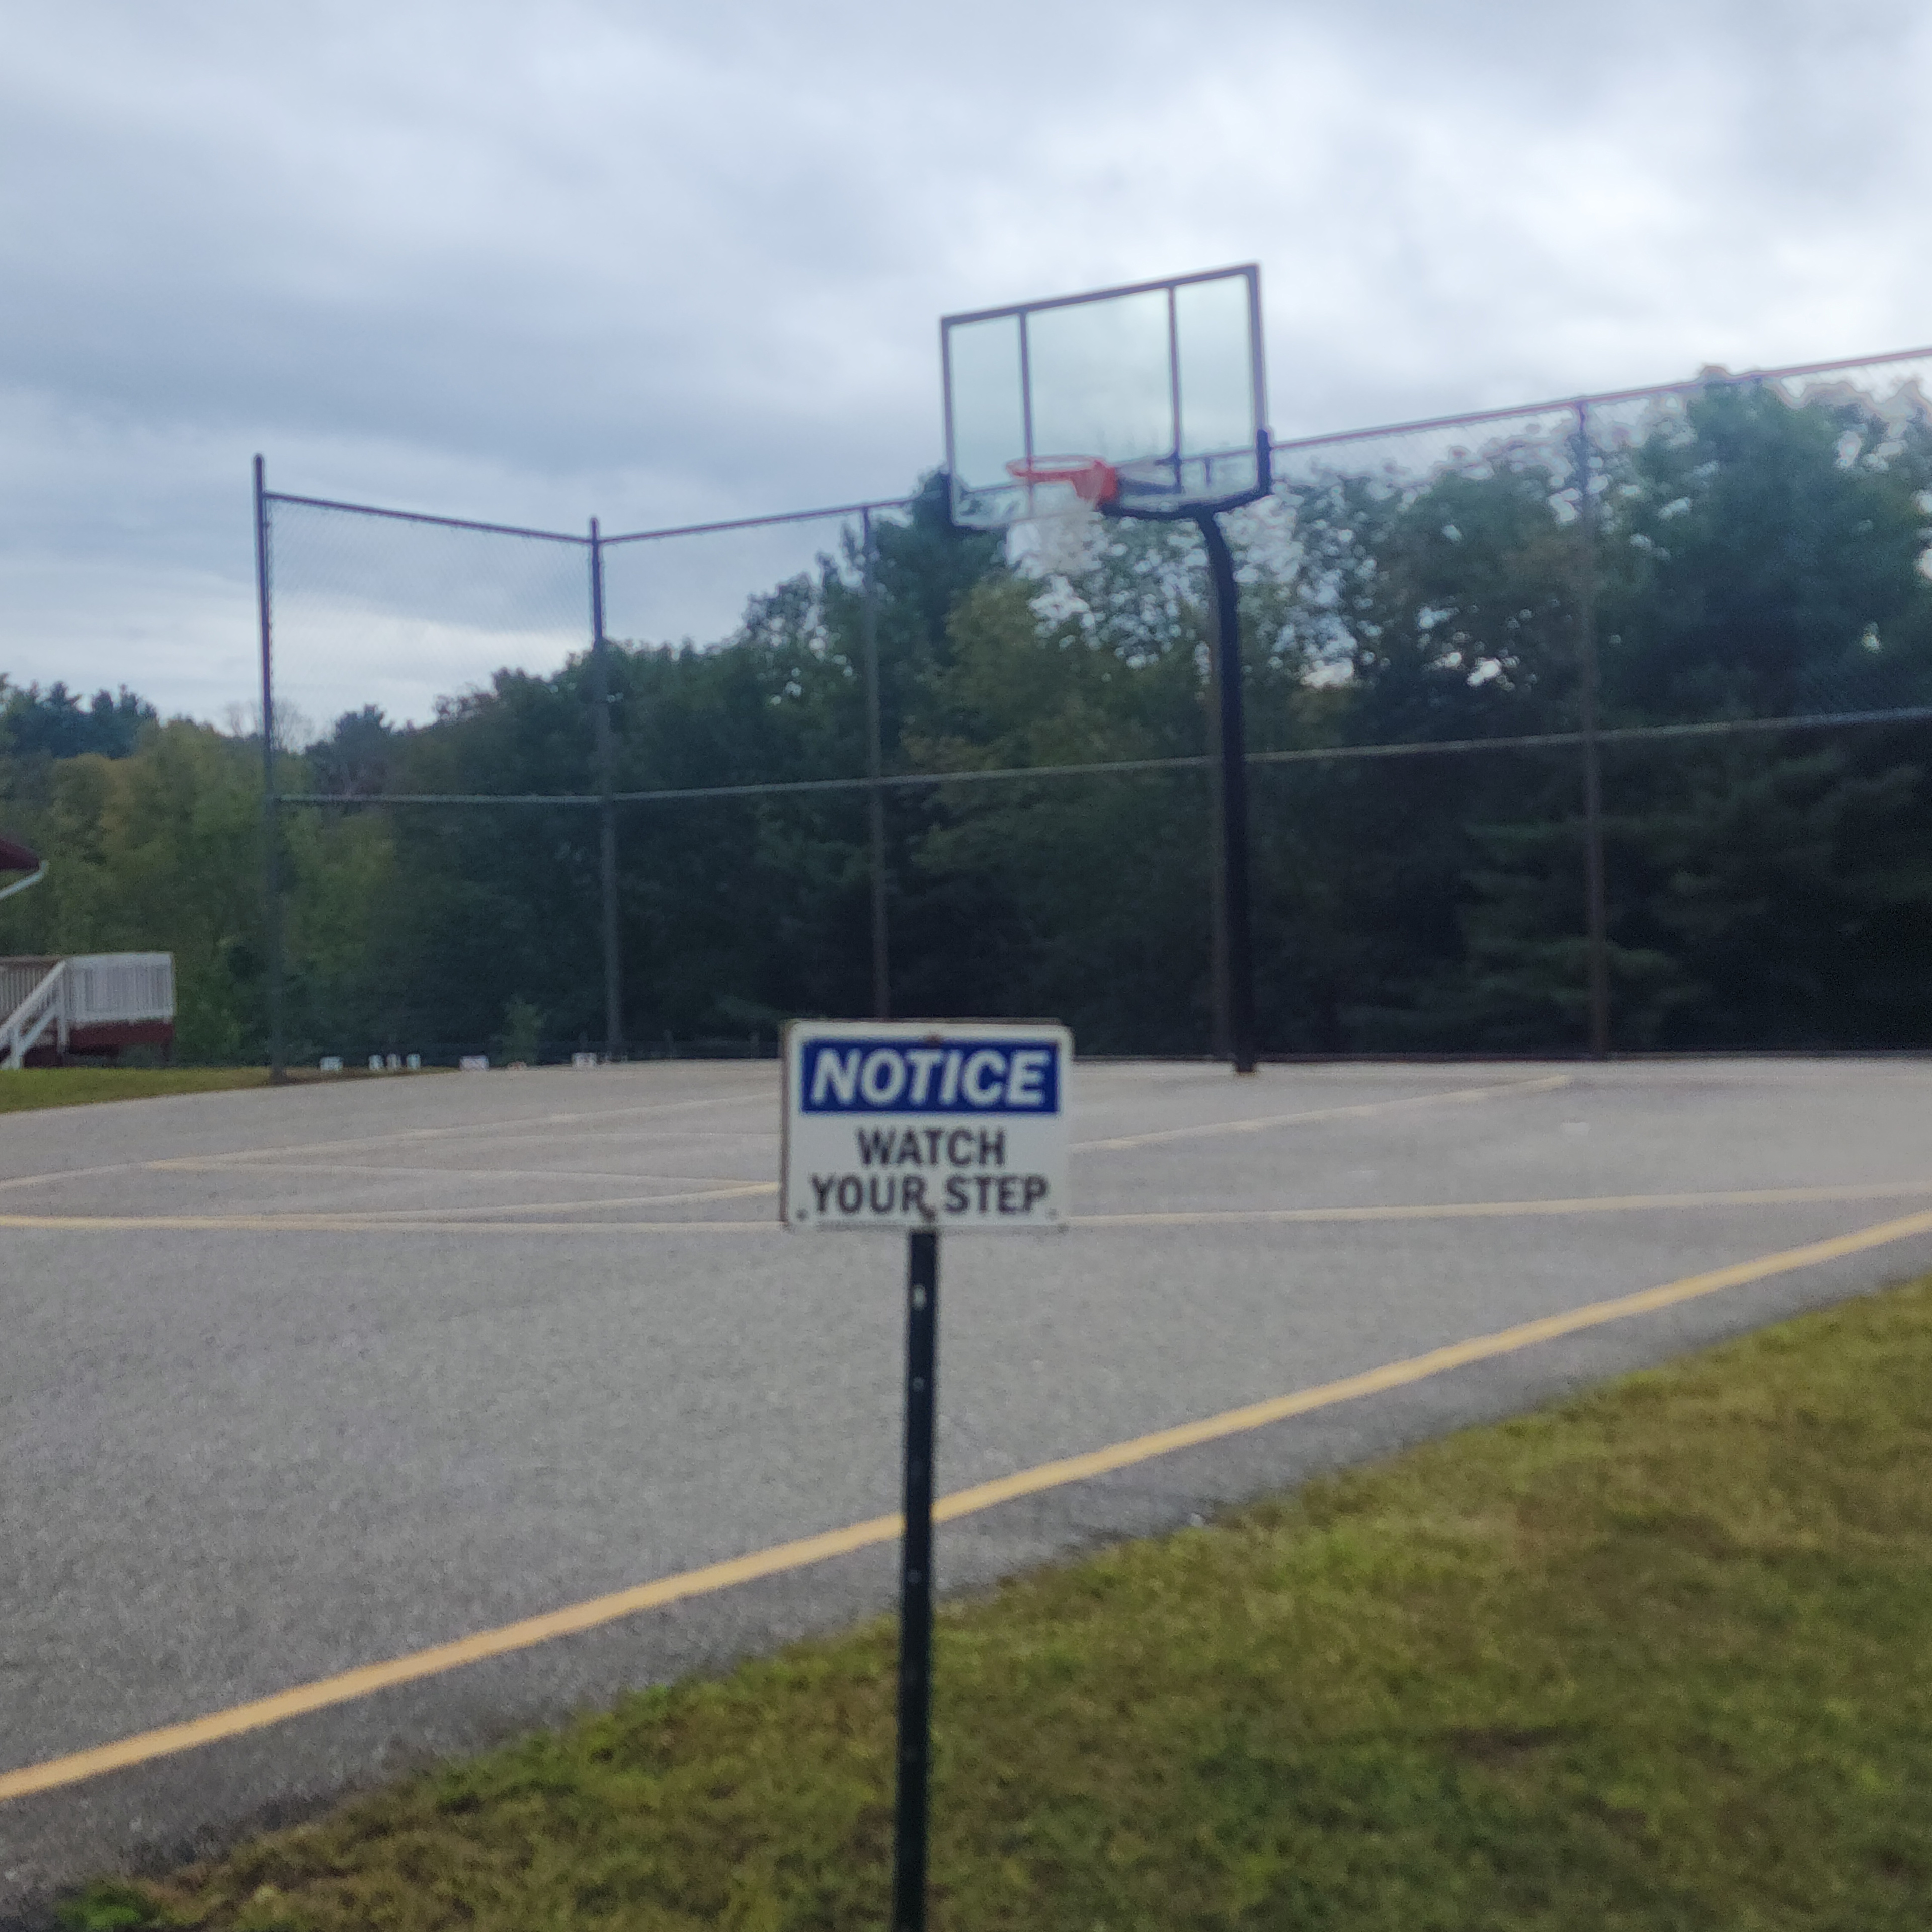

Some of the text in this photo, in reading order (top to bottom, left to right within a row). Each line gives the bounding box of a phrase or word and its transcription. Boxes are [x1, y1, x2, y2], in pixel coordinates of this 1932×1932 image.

[810, 1048, 1052, 1106] NOTICE
[857, 1125, 1006, 1166] WATCH
[810, 1173, 1050, 1215] YOUR STEP
